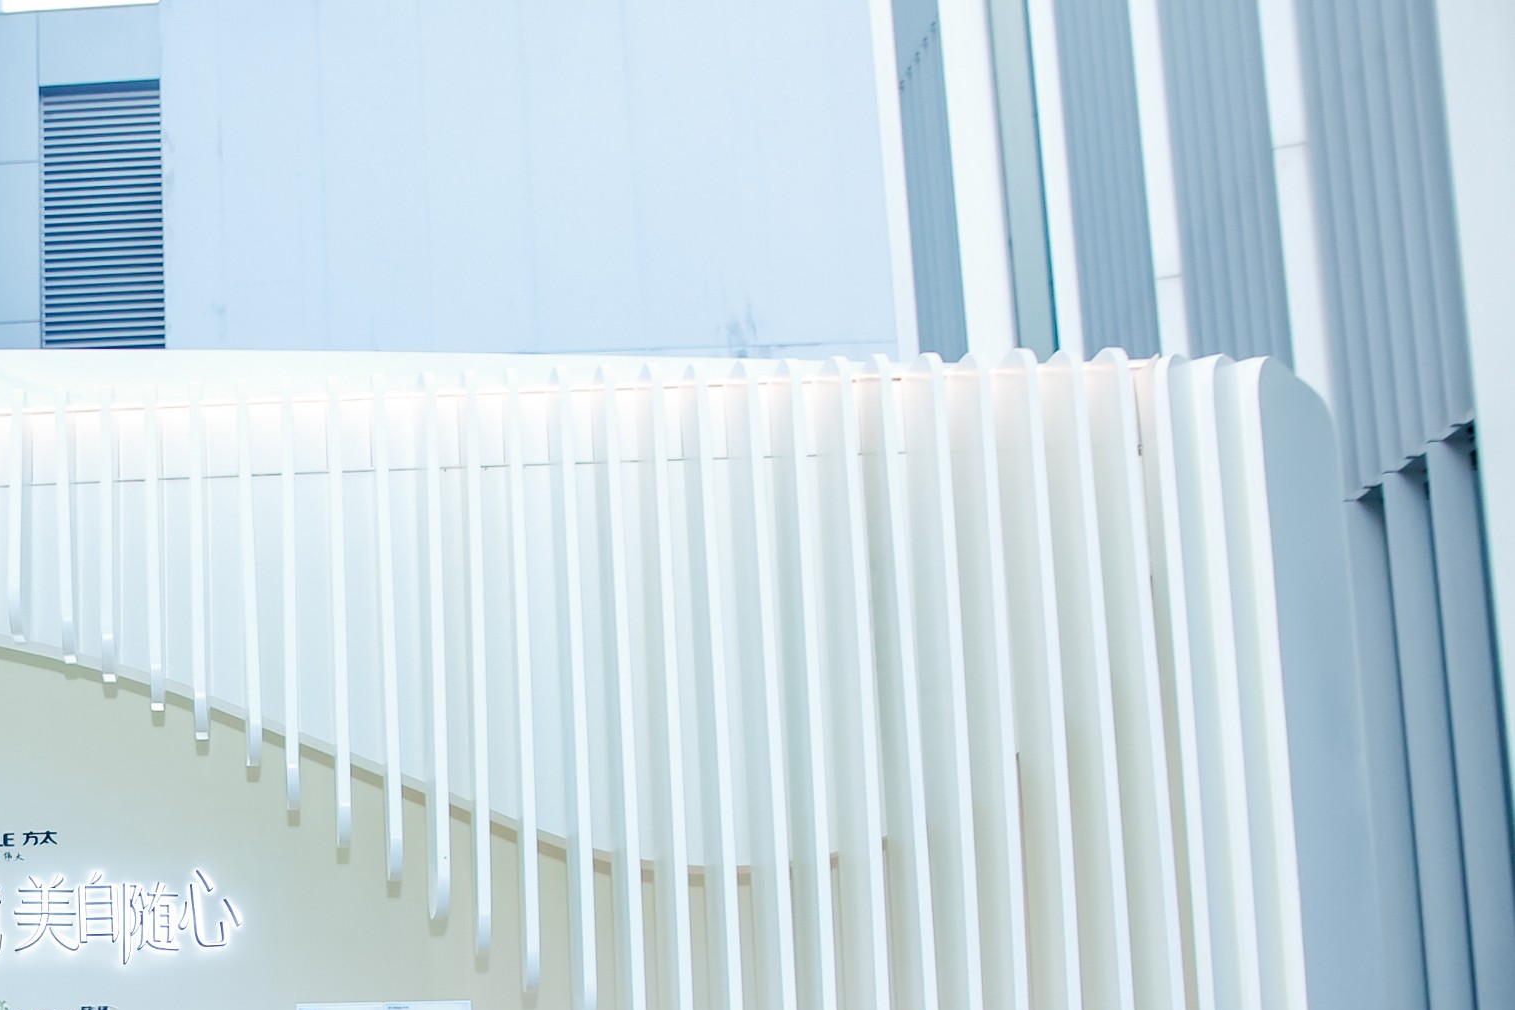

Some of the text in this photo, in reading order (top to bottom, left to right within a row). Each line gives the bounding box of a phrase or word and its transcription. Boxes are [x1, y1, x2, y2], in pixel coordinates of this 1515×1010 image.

[23, 830, 58, 846] 方太
[13, 869, 244, 966] 美自随心
